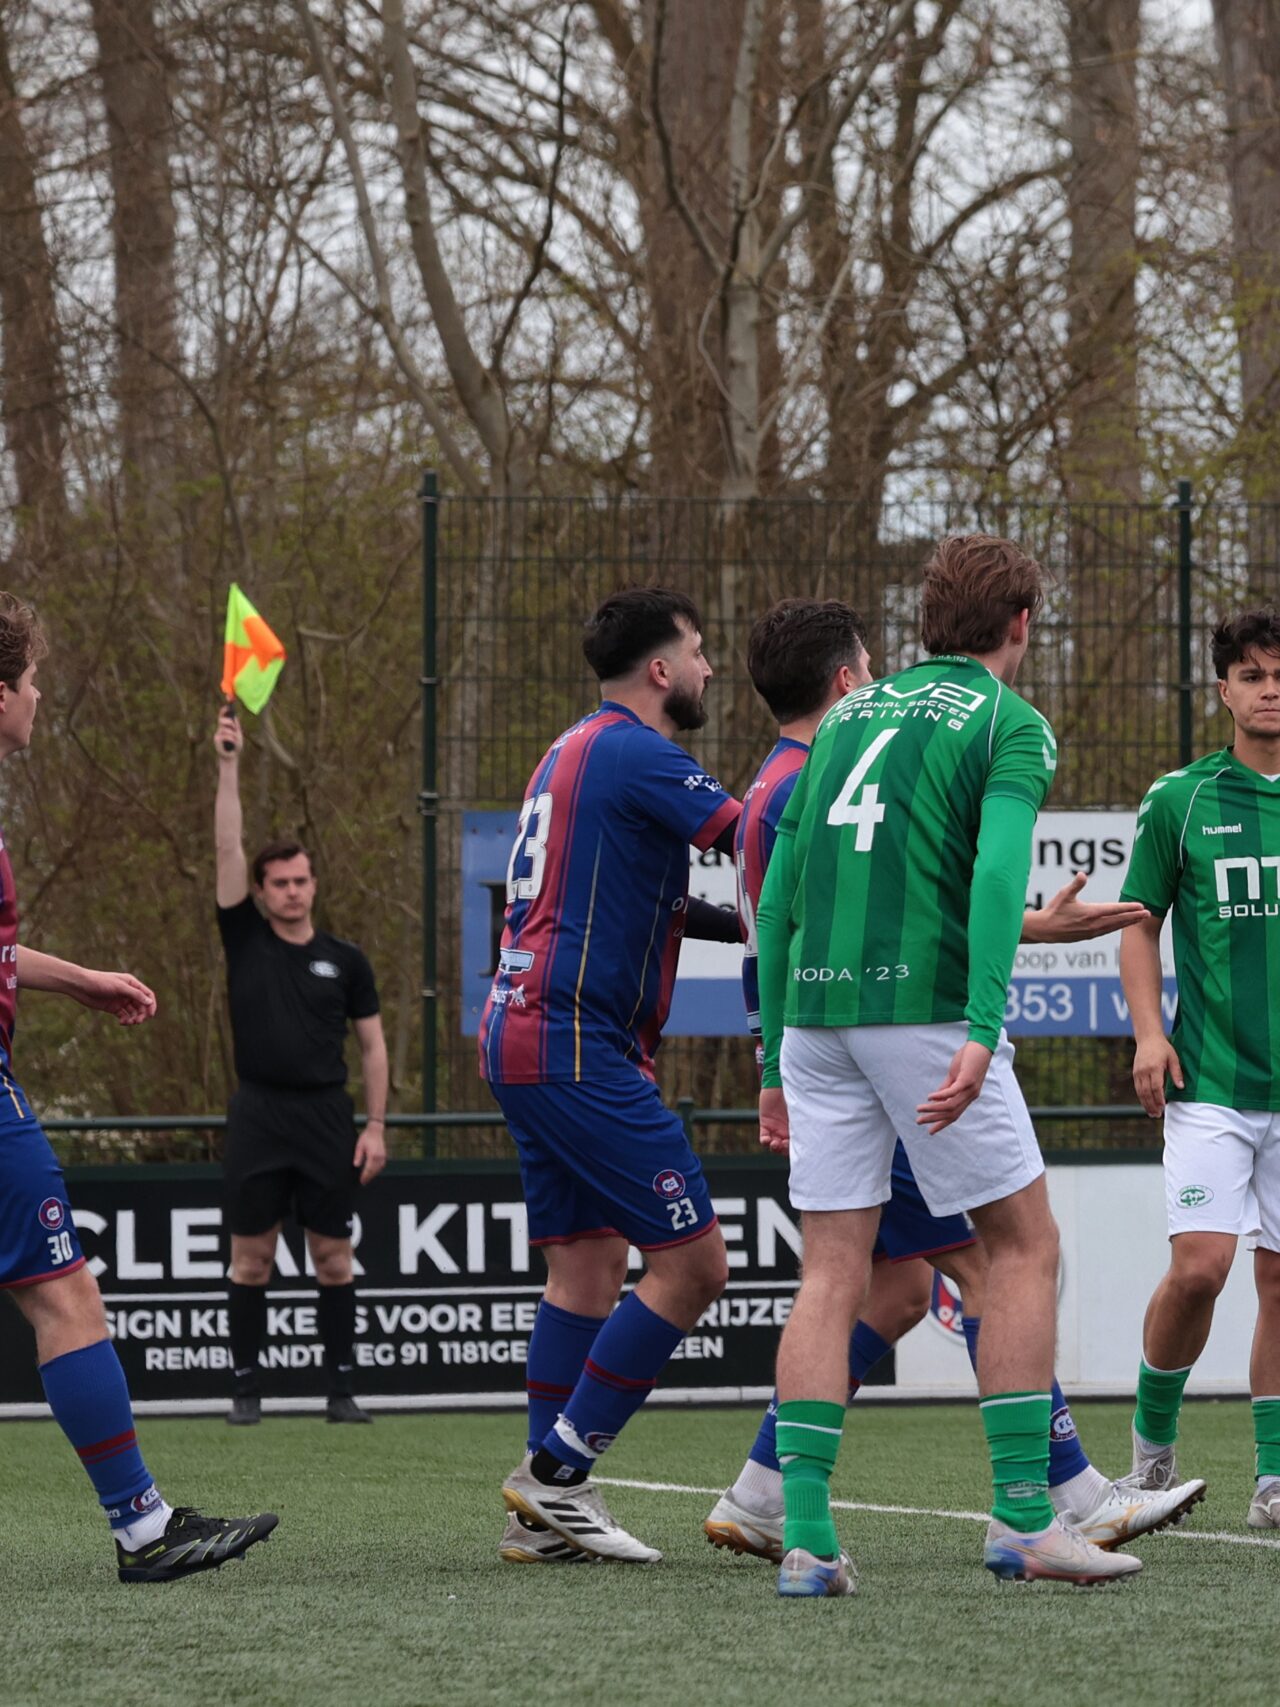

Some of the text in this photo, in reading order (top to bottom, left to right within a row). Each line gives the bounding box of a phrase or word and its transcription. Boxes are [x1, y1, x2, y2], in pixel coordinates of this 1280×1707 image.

[826, 708, 965, 731] TRAINING
[906, 699, 971, 720] SOCCER
[827, 728, 900, 852] 4
[1202, 822, 1243, 836] hummel
[507, 792, 553, 904] 23
[1065, 951, 1107, 970] van
[793, 964, 911, 982] RODA '23
[666, 1197, 699, 1231] 23
[47, 1231, 74, 1266] 30
[375, 1302, 483, 1334] VOOR
[400, 1341, 428, 1365] 91
